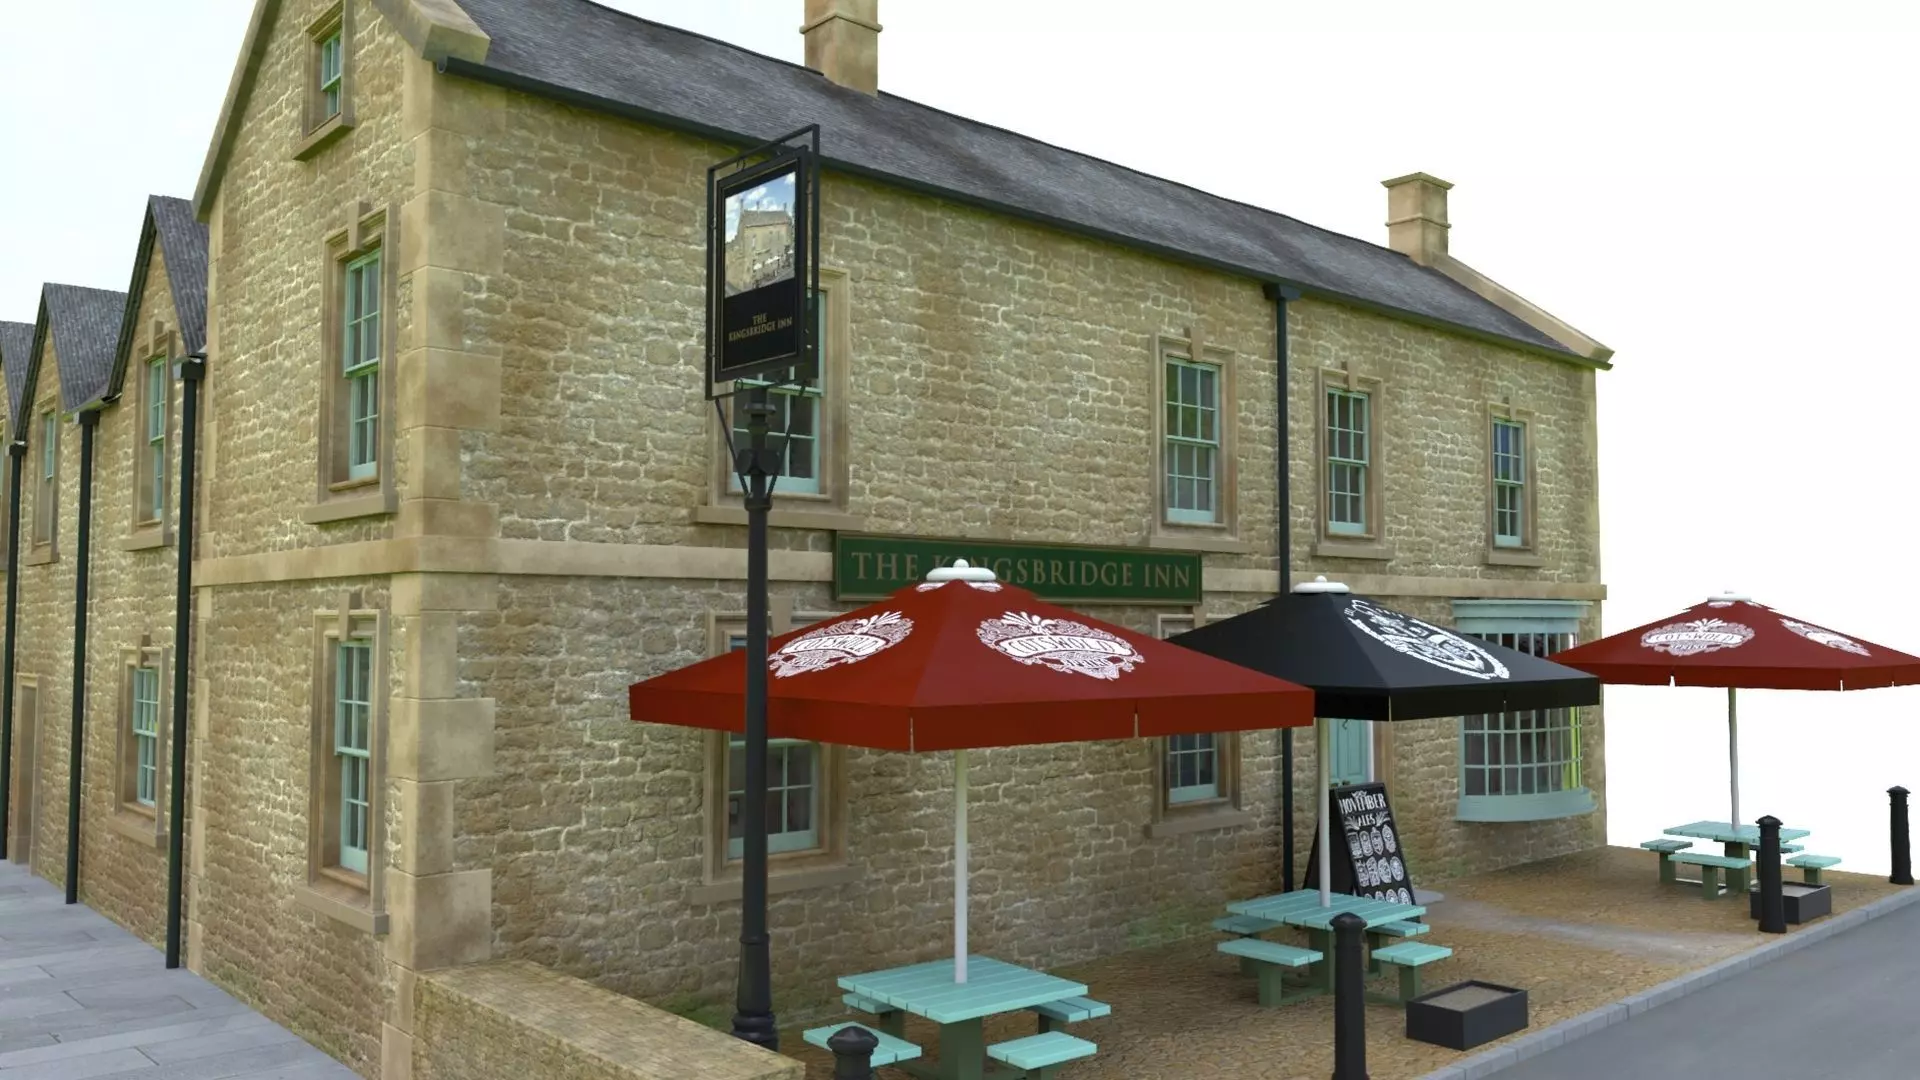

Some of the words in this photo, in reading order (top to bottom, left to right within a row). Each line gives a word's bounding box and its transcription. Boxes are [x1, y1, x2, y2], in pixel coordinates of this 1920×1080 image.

[752, 313, 768, 325] THE
[729, 321, 776, 342] KINGSBRIDGE
[778, 317, 793, 329] INN
[851, 552, 919, 581] THE
[933, 554, 1133, 587] KNGSBRIDGE
[1144, 564, 1191, 588] INN
[1007, 635, 1116, 653] COTSWOLD
[1339, 793, 1387, 814] NOVEMBER
[1358, 814, 1376, 826] ALES
